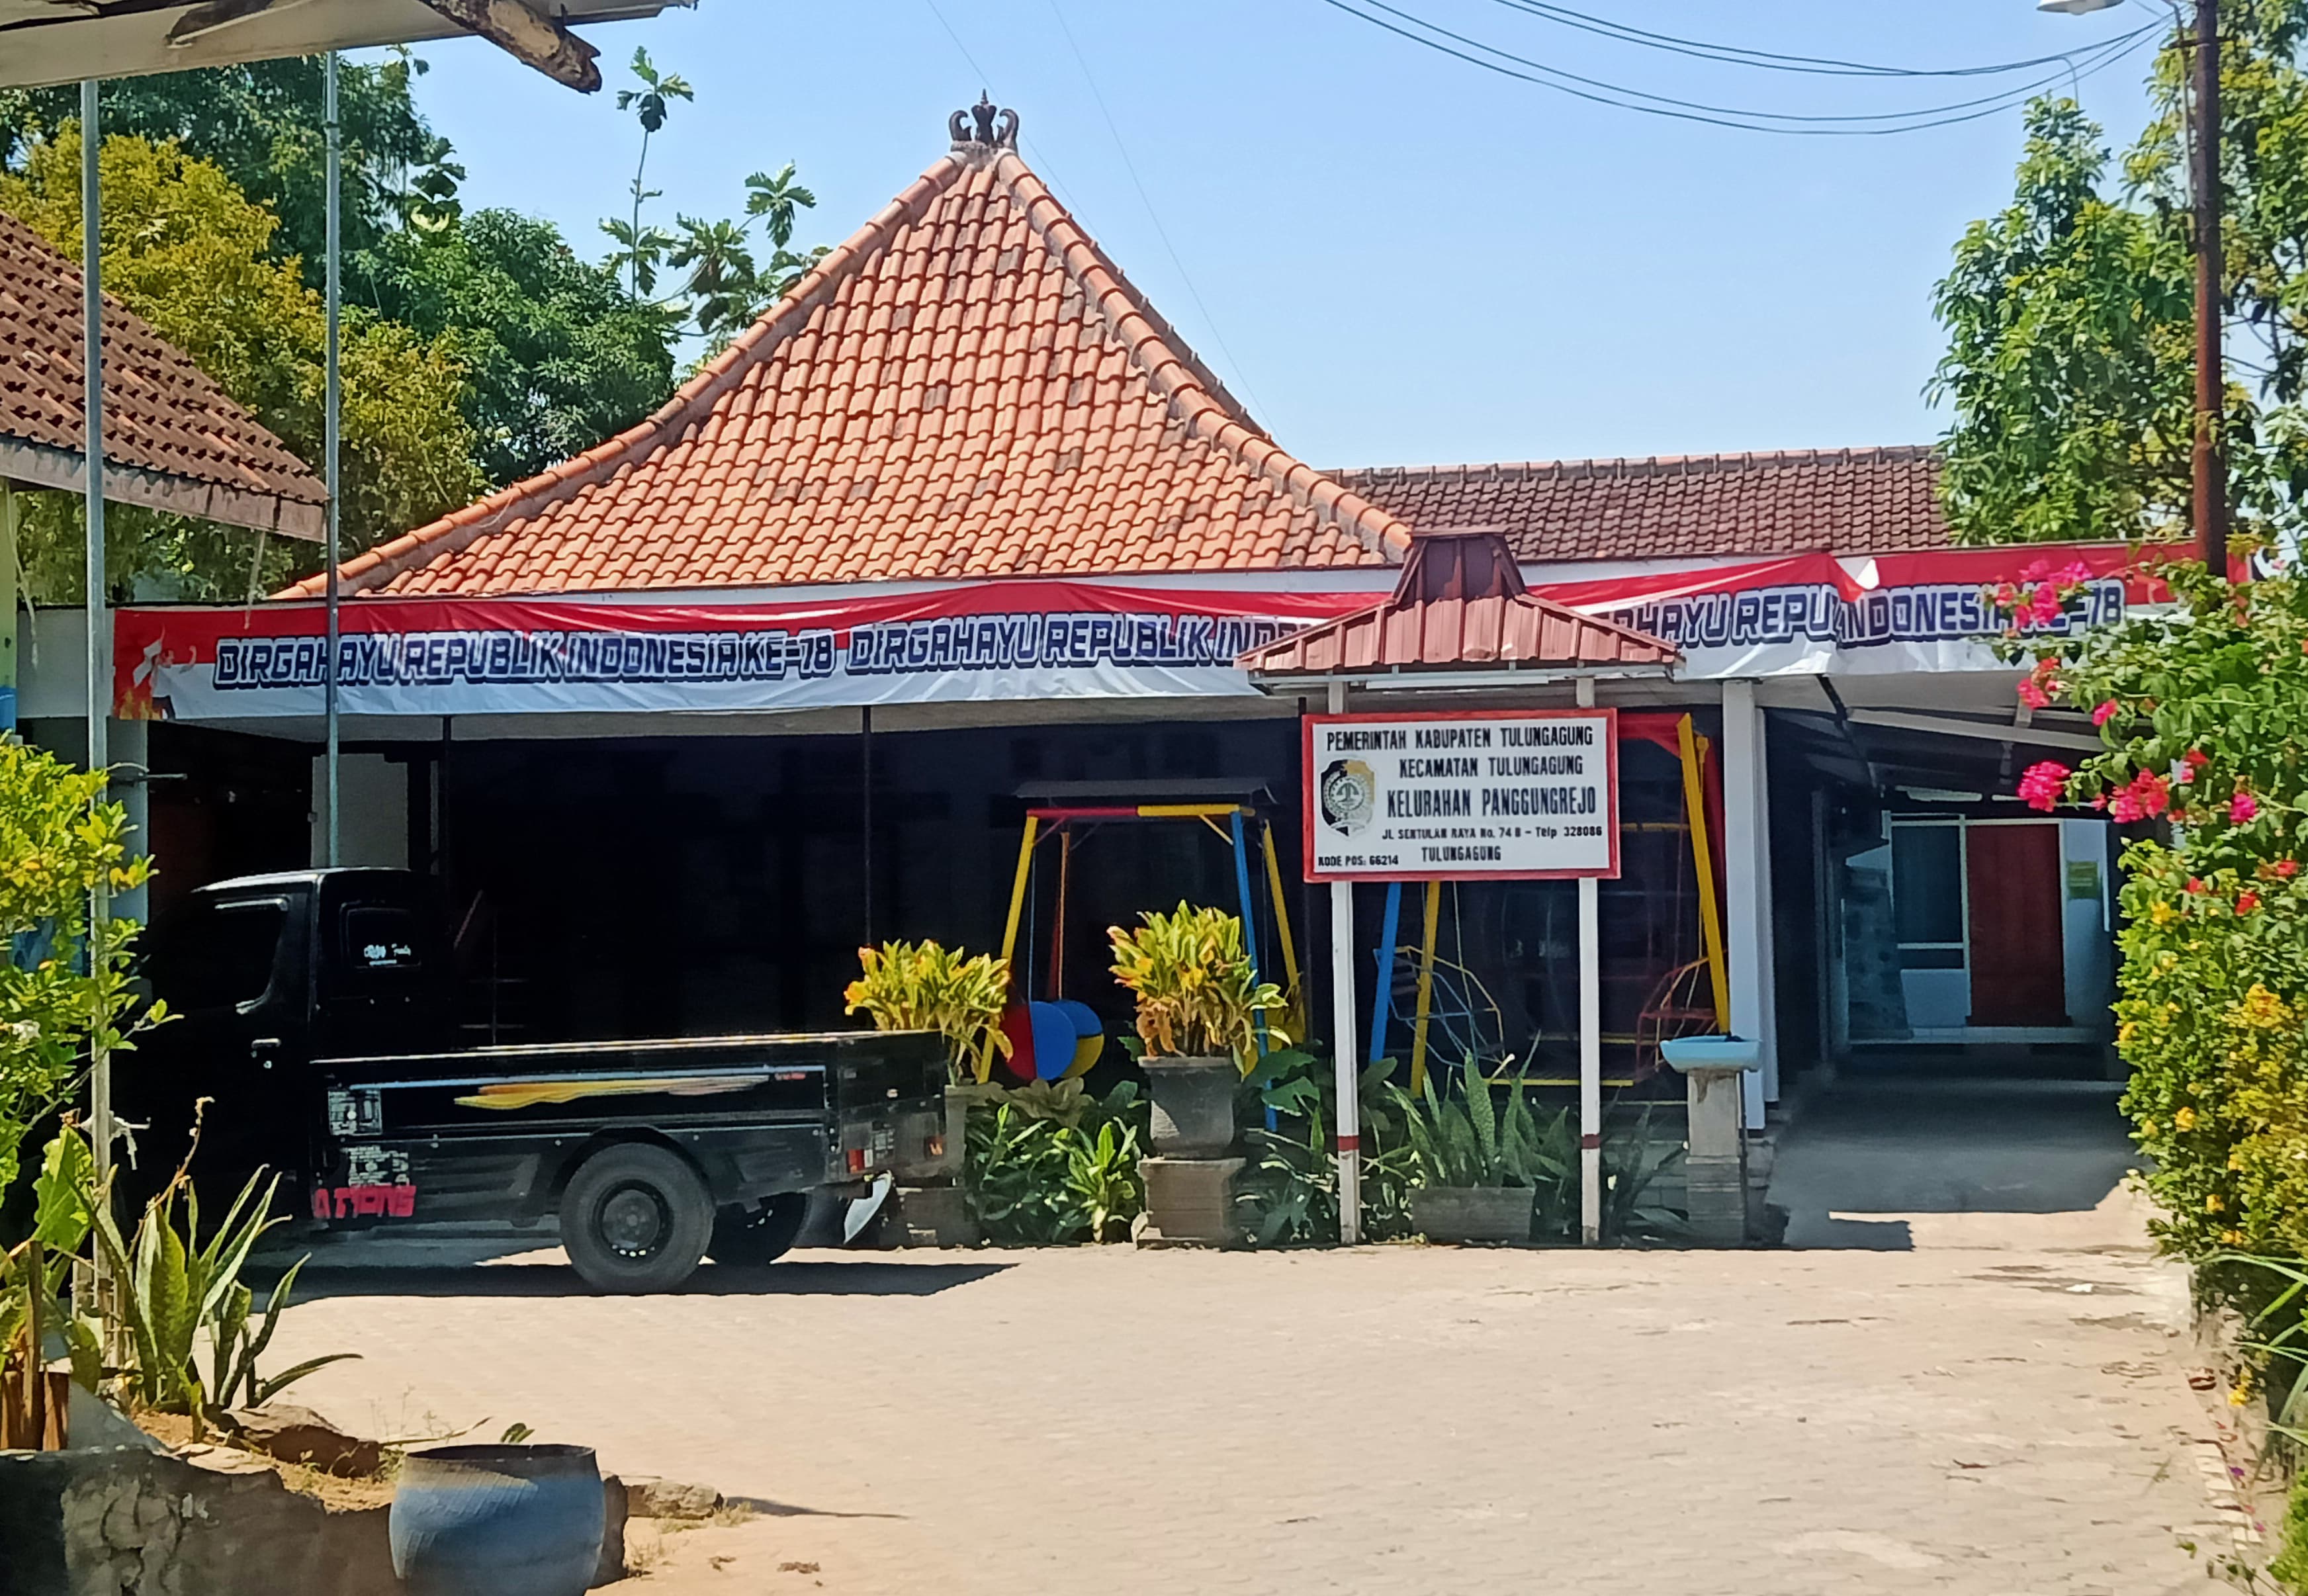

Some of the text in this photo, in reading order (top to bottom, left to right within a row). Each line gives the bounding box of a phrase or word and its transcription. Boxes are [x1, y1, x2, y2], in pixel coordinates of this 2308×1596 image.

[213, 633, 398, 689] DIRGAHAYU
[398, 629, 562, 686] REPUBLIK
[563, 631, 740, 683] INDONESIA
[736, 627, 836, 680] KE-78
[845, 611, 1043, 676] DIRGAHAYU
[1042, 611, 1214, 668] REPUBLIK
[1327, 726, 1593, 751] PEMERINTAH KABUPATEN TULUNGAGUNG
[1399, 755, 1583, 778] KECAMATAN TULUNGAGUNG
[1387, 786, 1596, 818] KELURAHAN PANGGUNGREJO
[1398, 828, 1448, 839] SENTULAN
[1451, 828, 1476, 838] RAYA
[1535, 826, 1558, 839] Telp
[1317, 856, 1342, 866] KODE
[1421, 845, 1501, 861] TULUNGAGUNG
